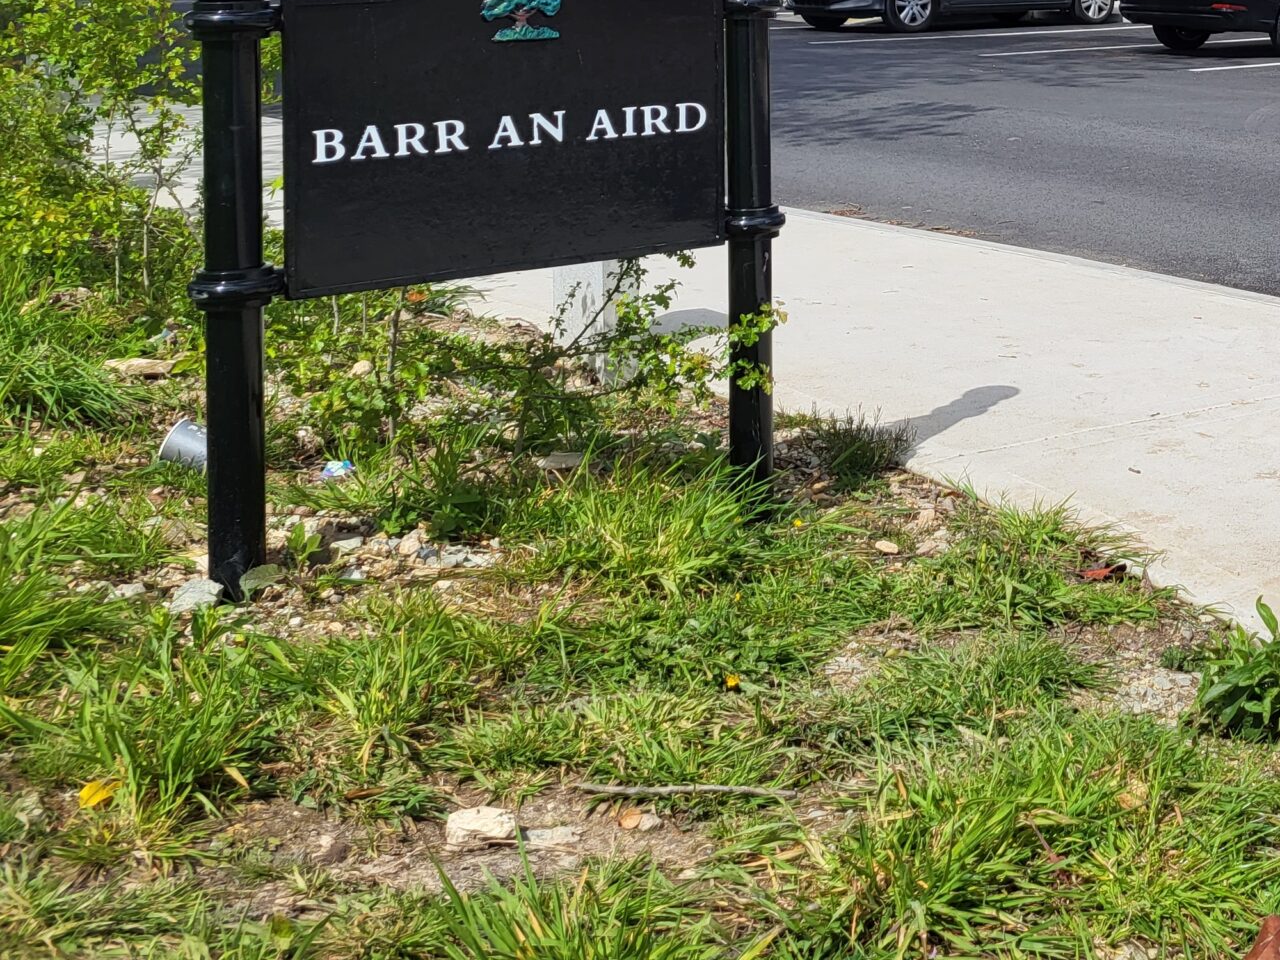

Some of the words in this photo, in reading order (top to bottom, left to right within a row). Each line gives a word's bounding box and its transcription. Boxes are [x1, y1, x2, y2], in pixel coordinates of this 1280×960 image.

[312, 119, 469, 163] BARR
[488, 110, 567, 149] AN
[586, 102, 707, 141] AIRD
